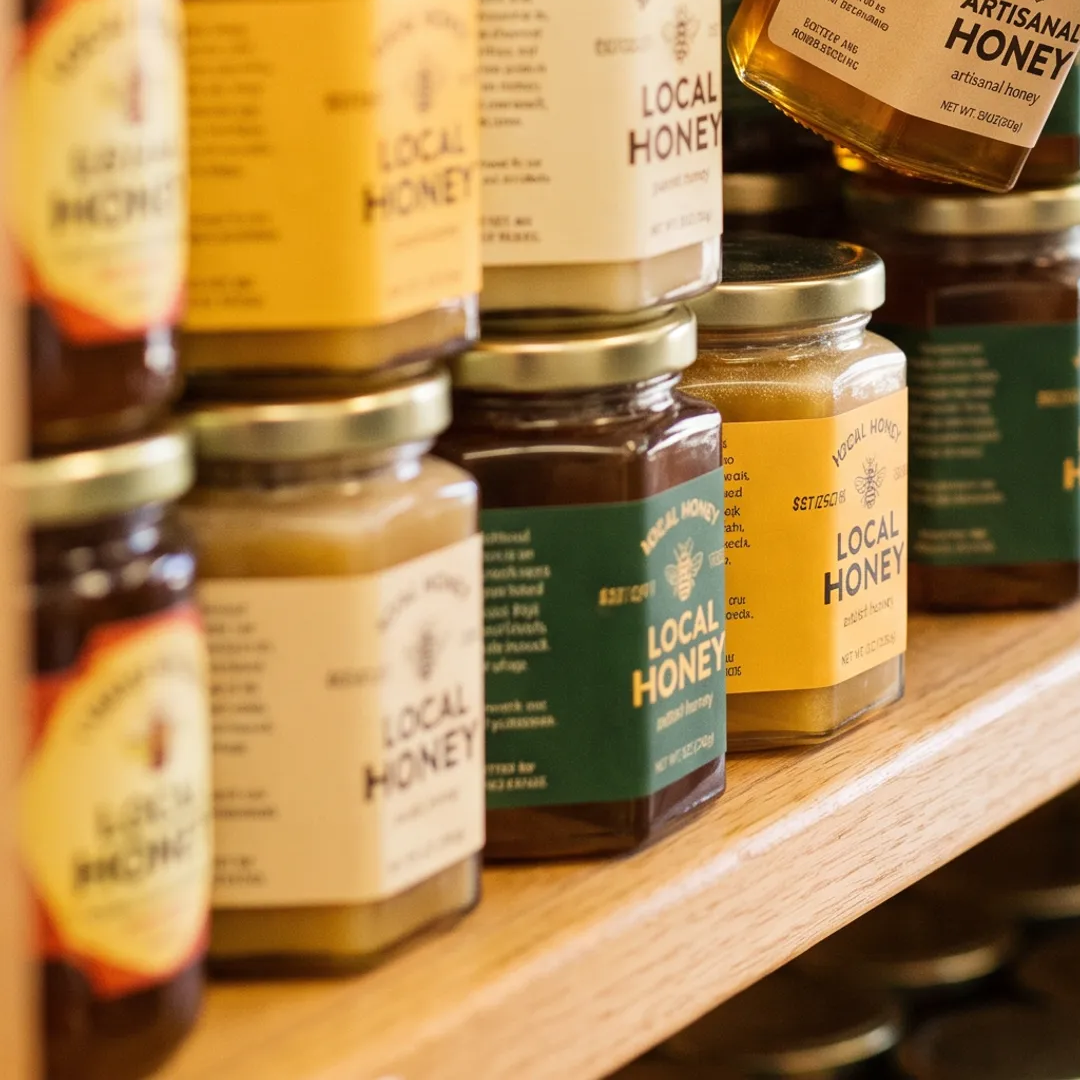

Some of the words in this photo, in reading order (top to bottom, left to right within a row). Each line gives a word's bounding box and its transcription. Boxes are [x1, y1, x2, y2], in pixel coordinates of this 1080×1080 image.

[944, 17, 1075, 80] HONEY
[642, 71, 718, 119] LOCAL
[940, 100, 959, 113] NET
[960, 105, 976, 119] WT.
[951, 69, 1006, 94] artisanal
[1003, 82, 1042, 107] honey
[377, 124, 465, 173] LOCAL
[627, 110, 722, 166] HONEY
[362, 165, 474, 224] HONEY
[681, 498, 720, 526] HONEY
[837, 510, 899, 563] LOCAL
[824, 541, 905, 605] HONEY
[648, 599, 719, 661] LOCAL
[632, 630, 726, 708] HONEY
[382, 683, 470, 749] LOCAL
[362, 720, 479, 804] HONEY
